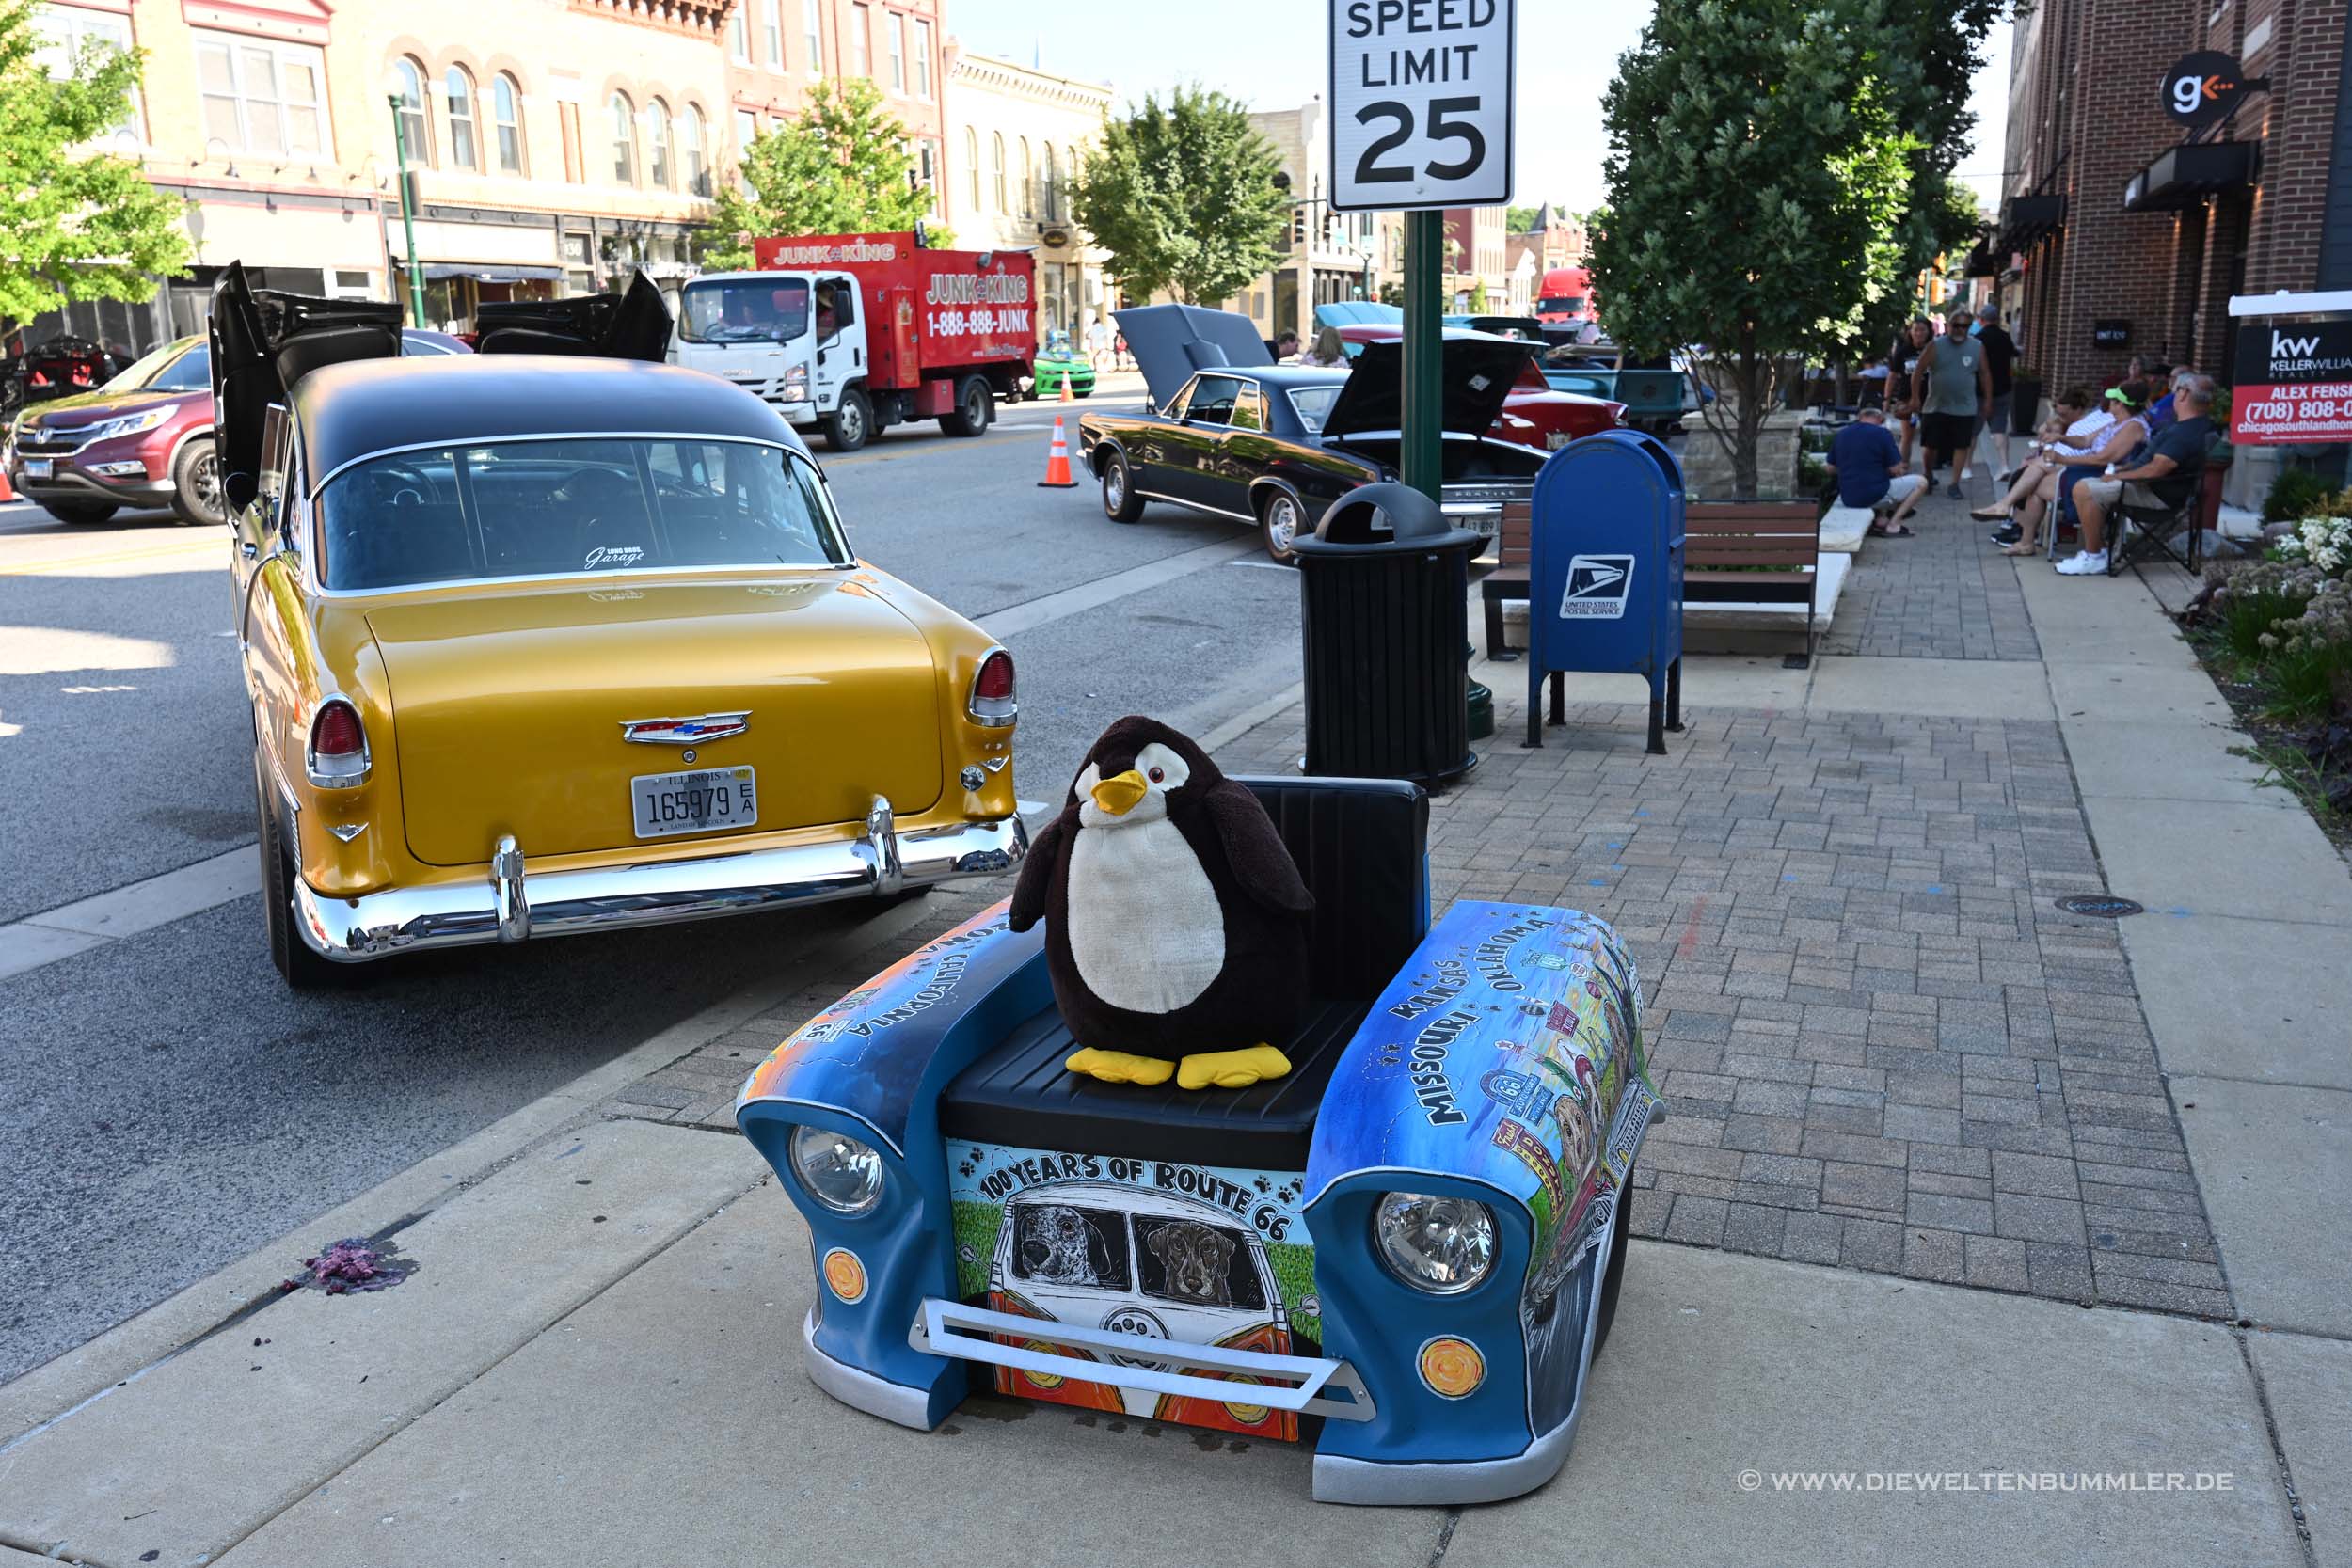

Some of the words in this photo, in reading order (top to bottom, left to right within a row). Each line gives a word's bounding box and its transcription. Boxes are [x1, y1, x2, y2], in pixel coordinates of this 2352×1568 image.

[1347, 0, 1496, 38] SPEED
[1362, 44, 1479, 87] LIMIT
[1354, 96, 1486, 184] 25
[774, 245, 832, 265] JUNK
[841, 243, 896, 263] KING
[926, 274, 978, 306] JUNK
[987, 273, 1028, 306] KING
[927, 309, 1030, 339] 1-888-888-JUNK
[2271, 329, 2321, 358] kw
[2270, 386, 2309, 400] ALEX
[2245, 402, 2294, 422] (708)
[584, 546, 645, 570] Garage
[669, 771, 721, 785] ILLINOIS
[646, 786, 730, 824] 165979
[1472, 918, 1555, 992] OKLAHOMA
[846, 953, 971, 1037] CALIFORNIA
[1388, 959, 1470, 1021] KANSAS
[805, 1023, 833, 1038] 66
[1408, 1009, 1482, 1127] MISSOURI
[1500, 1079, 1522, 1097] 66
[978, 1167, 1013, 1204] 100
[1009, 1152, 1101, 1190] YEARS
[1107, 1156, 1145, 1183] OF
[1153, 1161, 1255, 1219] ROUTE
[1252, 1204, 1294, 1243] 66
